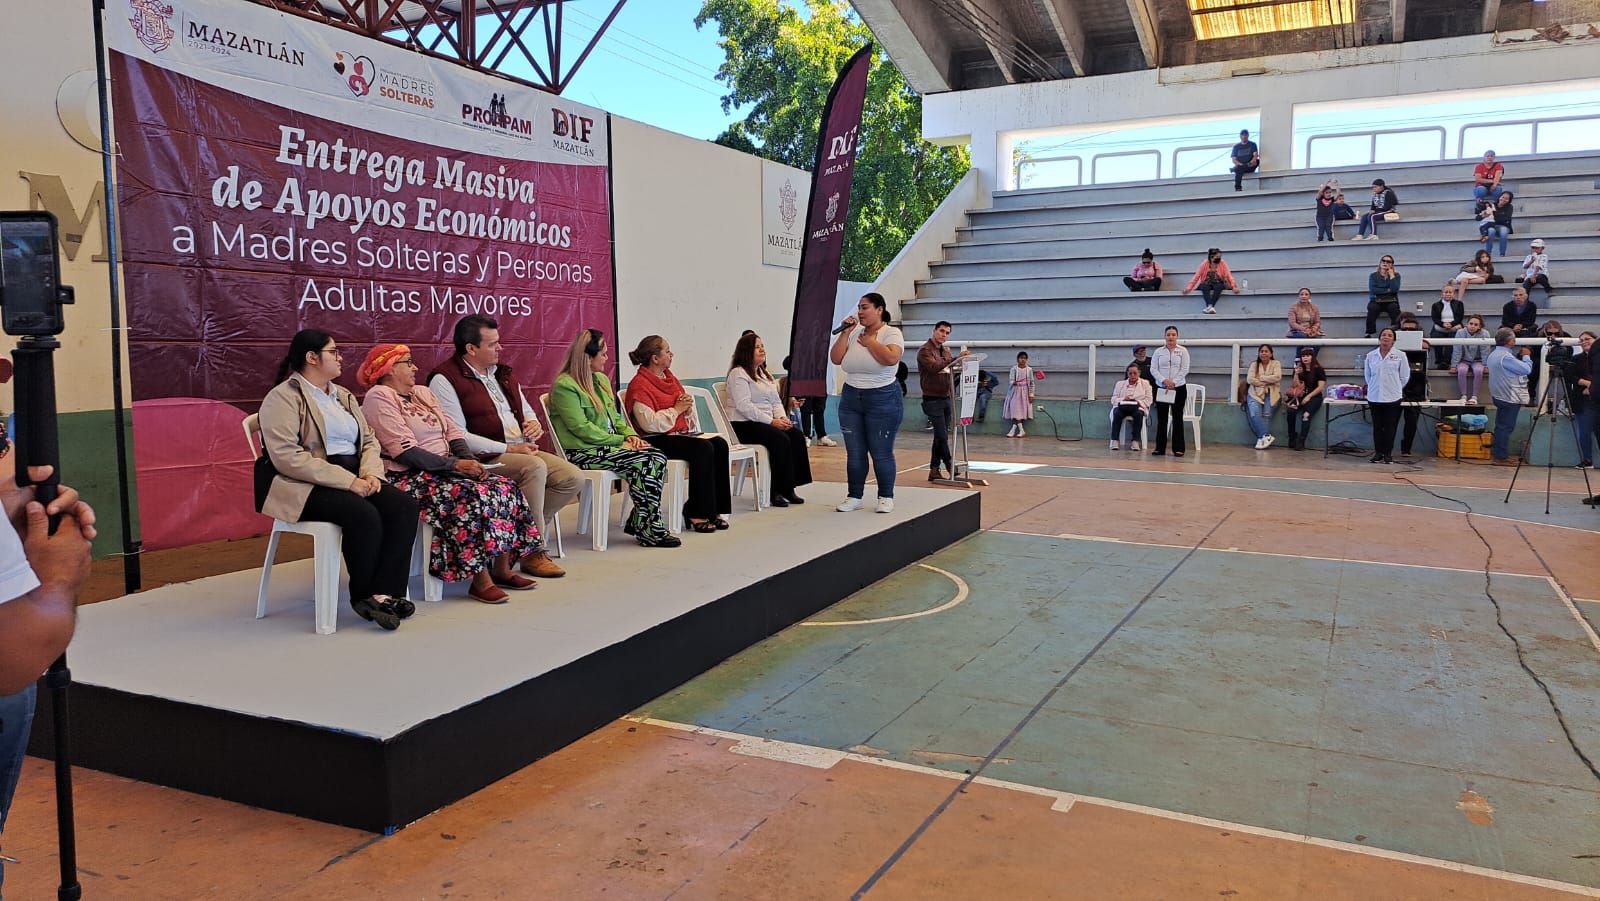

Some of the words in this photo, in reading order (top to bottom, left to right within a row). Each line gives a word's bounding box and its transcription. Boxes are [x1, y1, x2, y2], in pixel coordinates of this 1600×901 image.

[187, 20, 306, 67] MAZATLÁN
[380, 72, 434, 97] MADRES
[380, 86, 434, 109] SOLTERAS
[551, 107, 594, 144] DIF
[275, 125, 426, 192] Entrega
[433, 156, 534, 203] Masiva
[552, 139, 595, 158] MAZATLÁN
[211, 165, 263, 211] de
[272, 177, 406, 234] Apoyos
[414, 196, 571, 248] Económicos
[172, 224, 196, 254] a
[212, 222, 347, 266] Madres
[356, 236, 470, 274] Solteras
[475, 253, 491, 283] y
[497, 250, 593, 284] Personas
[299, 278, 422, 314] Adultas
[430, 286, 532, 317] Mayores
